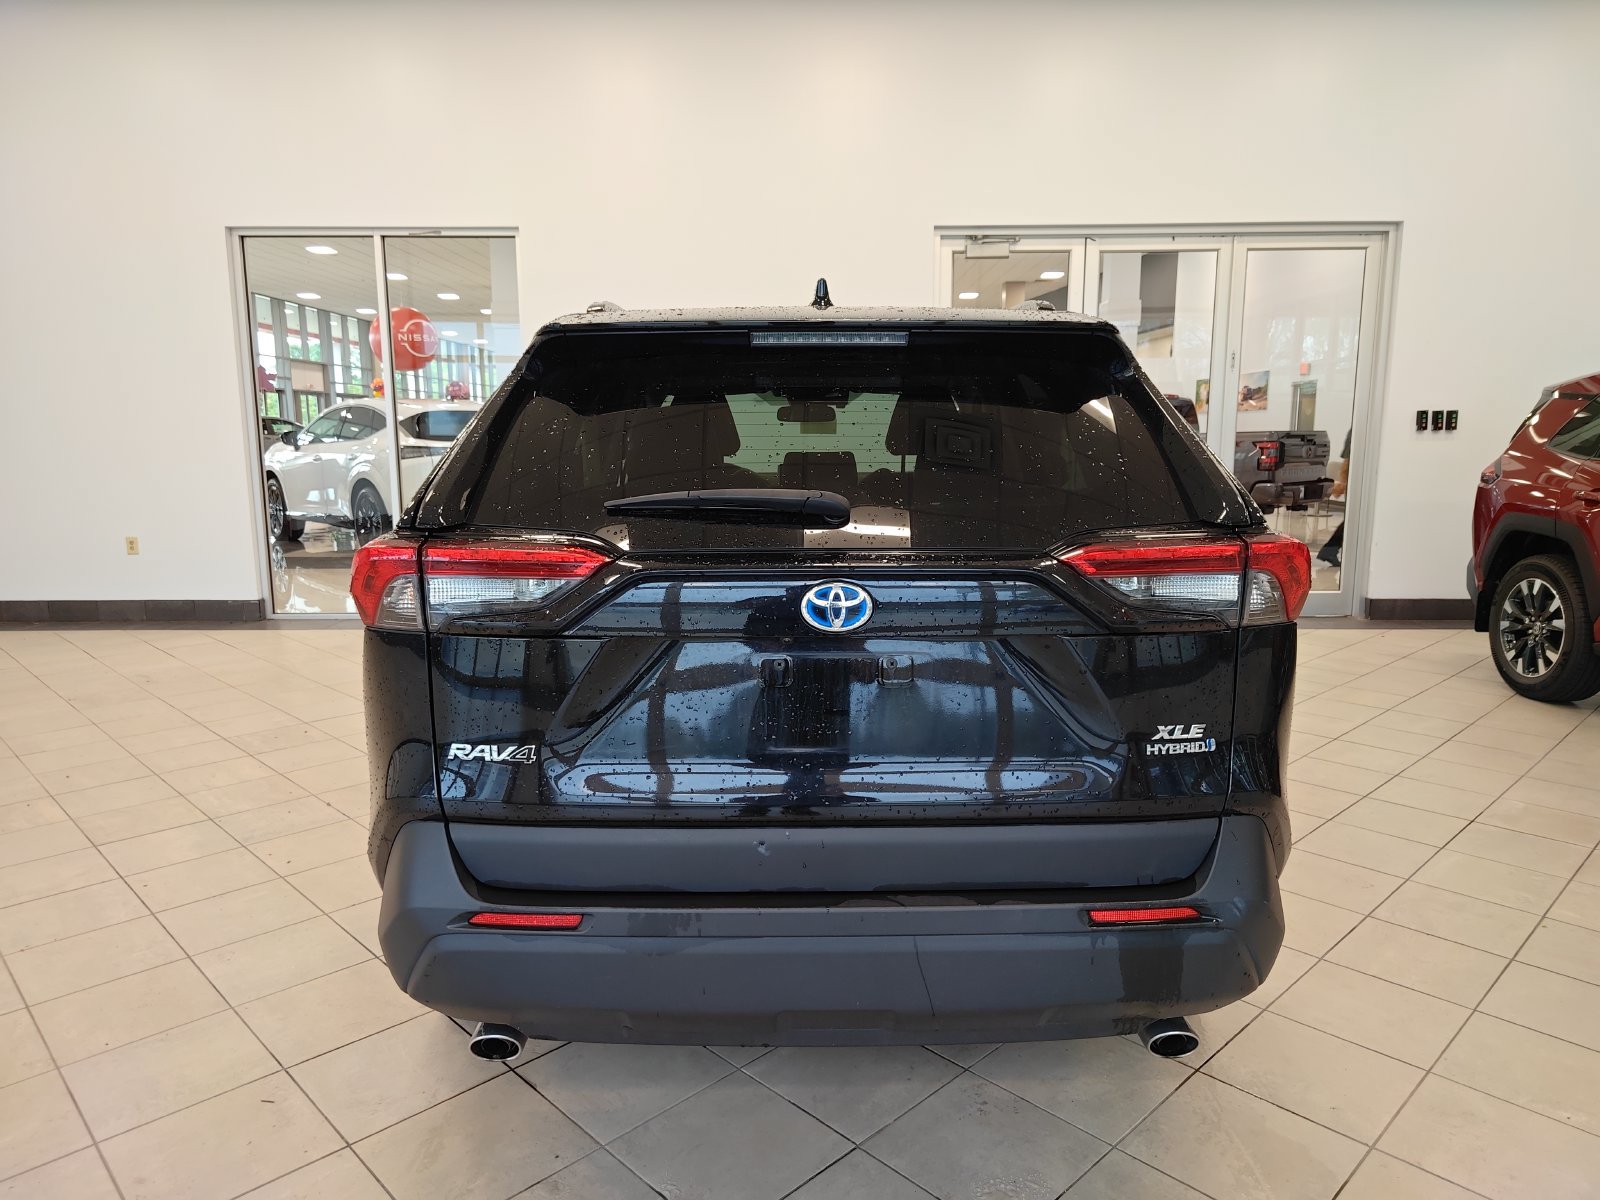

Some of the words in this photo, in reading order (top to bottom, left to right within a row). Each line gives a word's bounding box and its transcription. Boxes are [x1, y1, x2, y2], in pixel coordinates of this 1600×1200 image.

[1151, 723, 1207, 740] XLE
[447, 743, 537, 764] RAV4
[1146, 741, 1206, 755] HYBRID
